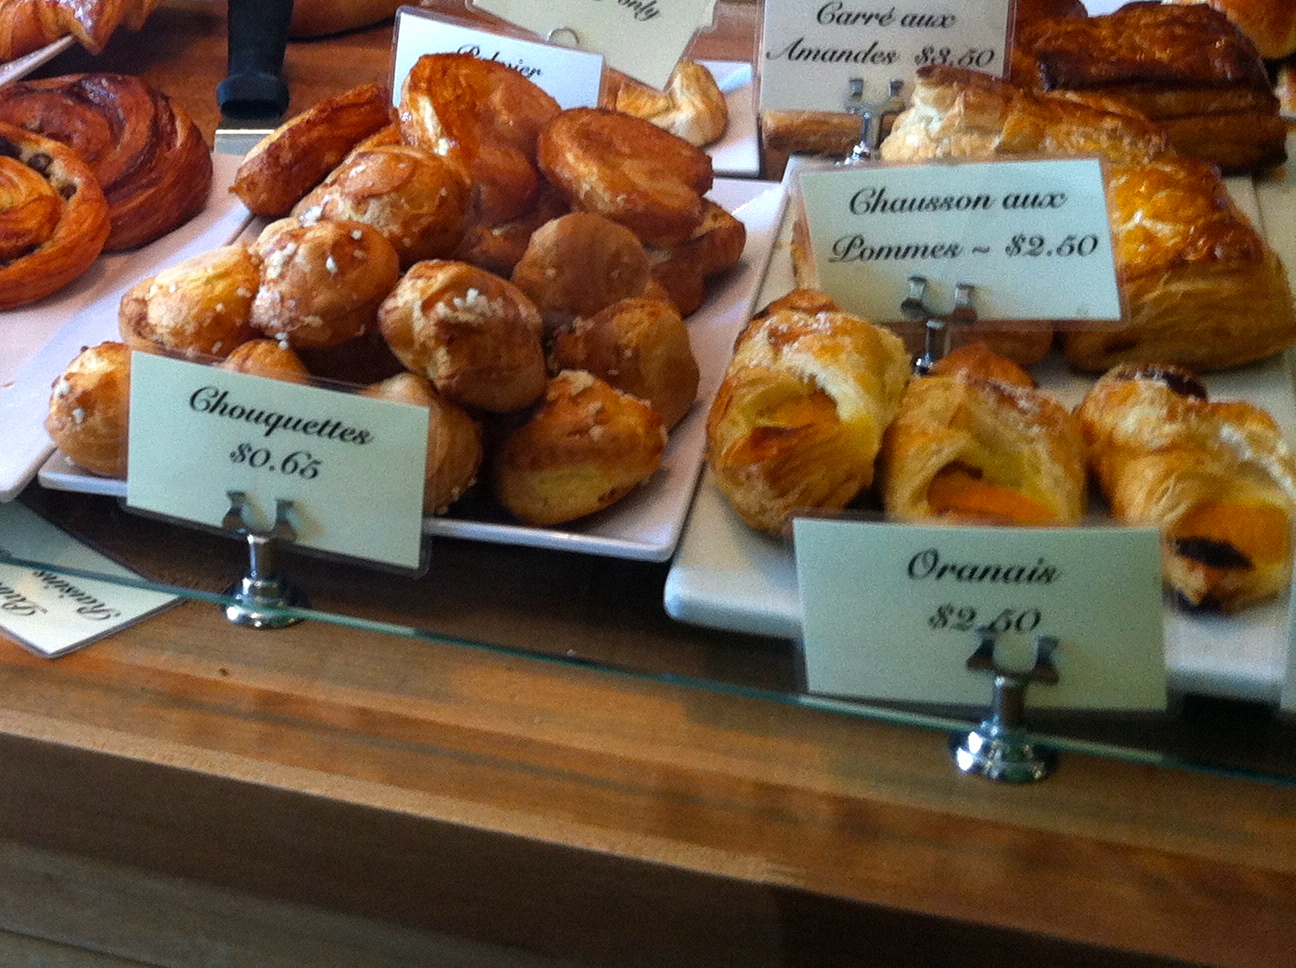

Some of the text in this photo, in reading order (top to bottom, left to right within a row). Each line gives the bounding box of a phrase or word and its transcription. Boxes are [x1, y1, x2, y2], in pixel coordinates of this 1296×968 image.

[817, 0, 957, 30] Carré aux
[766, 37, 900, 65] Amandes
[849, 186, 1068, 216] Chausson aux
[827, 233, 964, 263] Pommes
[1004, 232, 1099, 259] $2.50
[188, 385, 374, 446] Chouquettes
[230, 441, 324, 481] $0.65
[906, 547, 1061, 585] Oranais
[33, 568, 122, 622] Raisins
[927, 602, 1043, 633] $250
